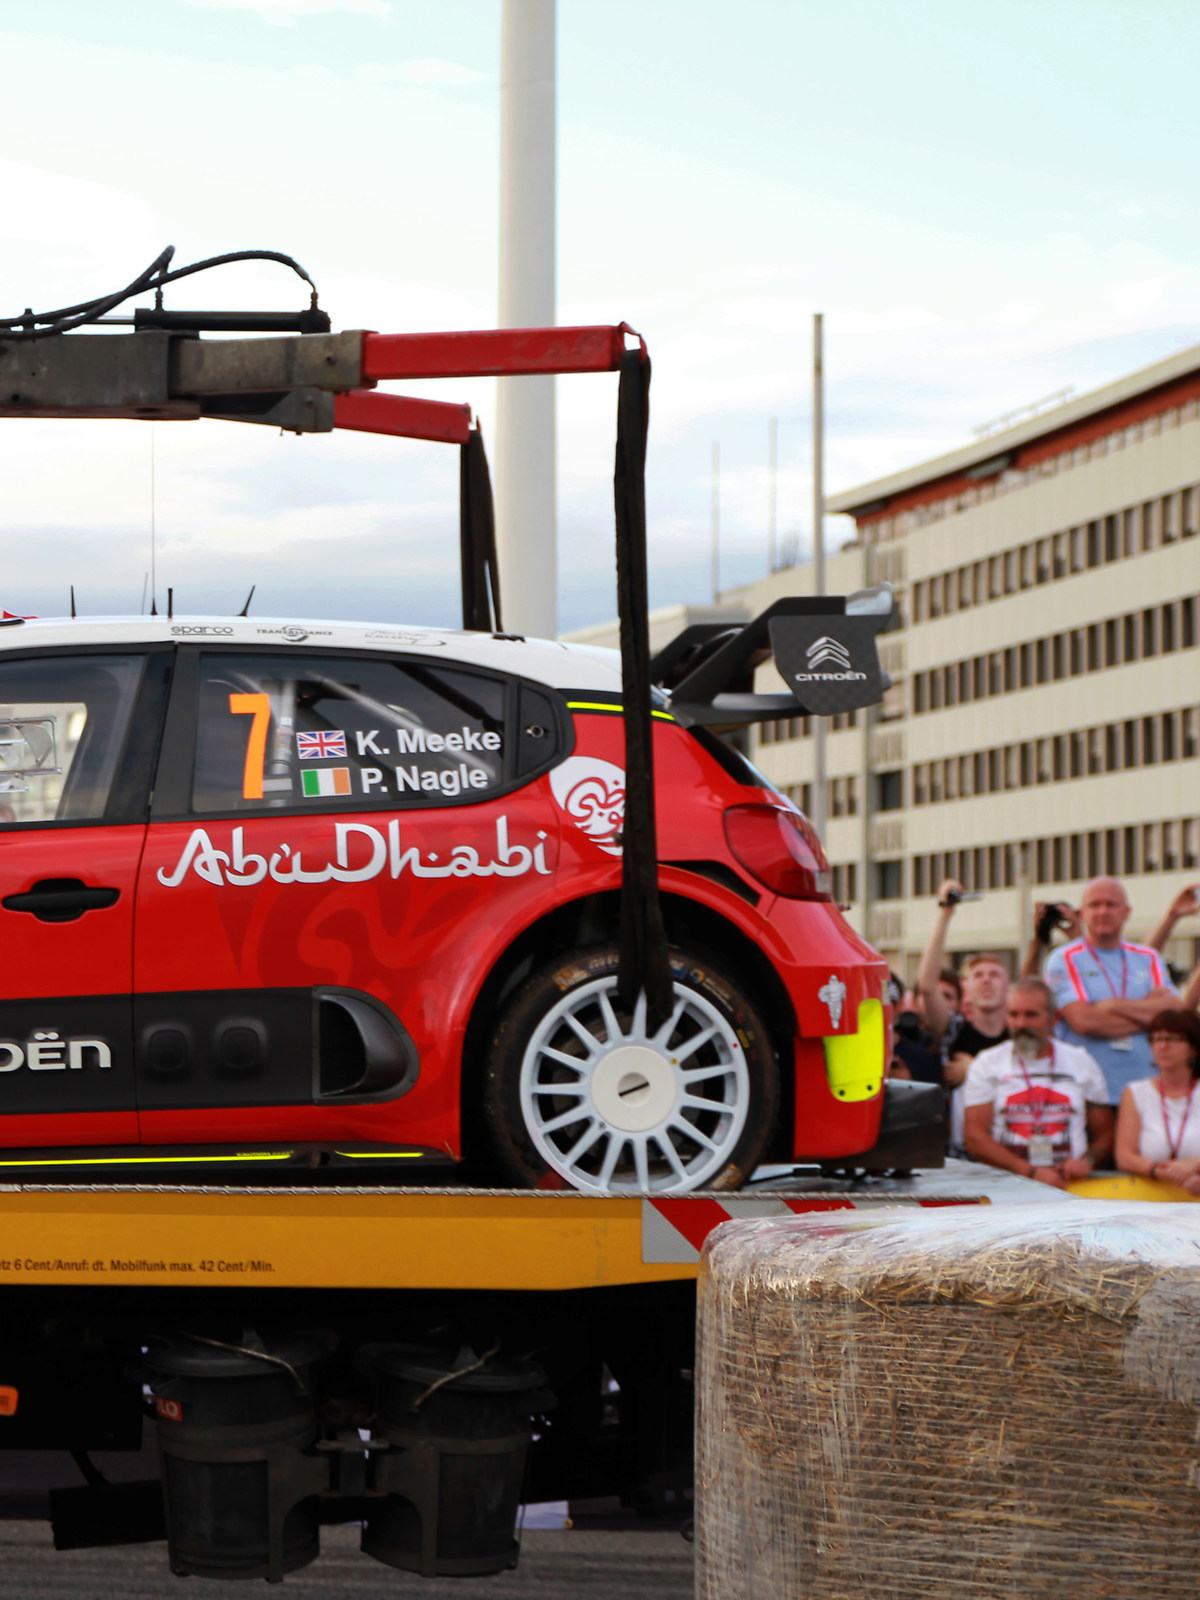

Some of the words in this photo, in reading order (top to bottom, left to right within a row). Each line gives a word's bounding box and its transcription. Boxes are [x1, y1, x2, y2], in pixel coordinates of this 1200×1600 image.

[170, 625, 234, 637] sparco
[229, 693, 271, 800] 7
[356, 730, 390, 755] K.
[397, 727, 502, 754] Meeke
[360, 768, 388, 794] P.
[396, 763, 489, 796] Nagle
[334, 815, 553, 883] Dhabi
[14, 1260, 22, 1270] 6
[92, 1261, 107, 1271] dt.
[110, 1260, 167, 1272] Mobilfunk
[169, 1262, 196, 1272] max.
[199, 1260, 215, 1272] 42
